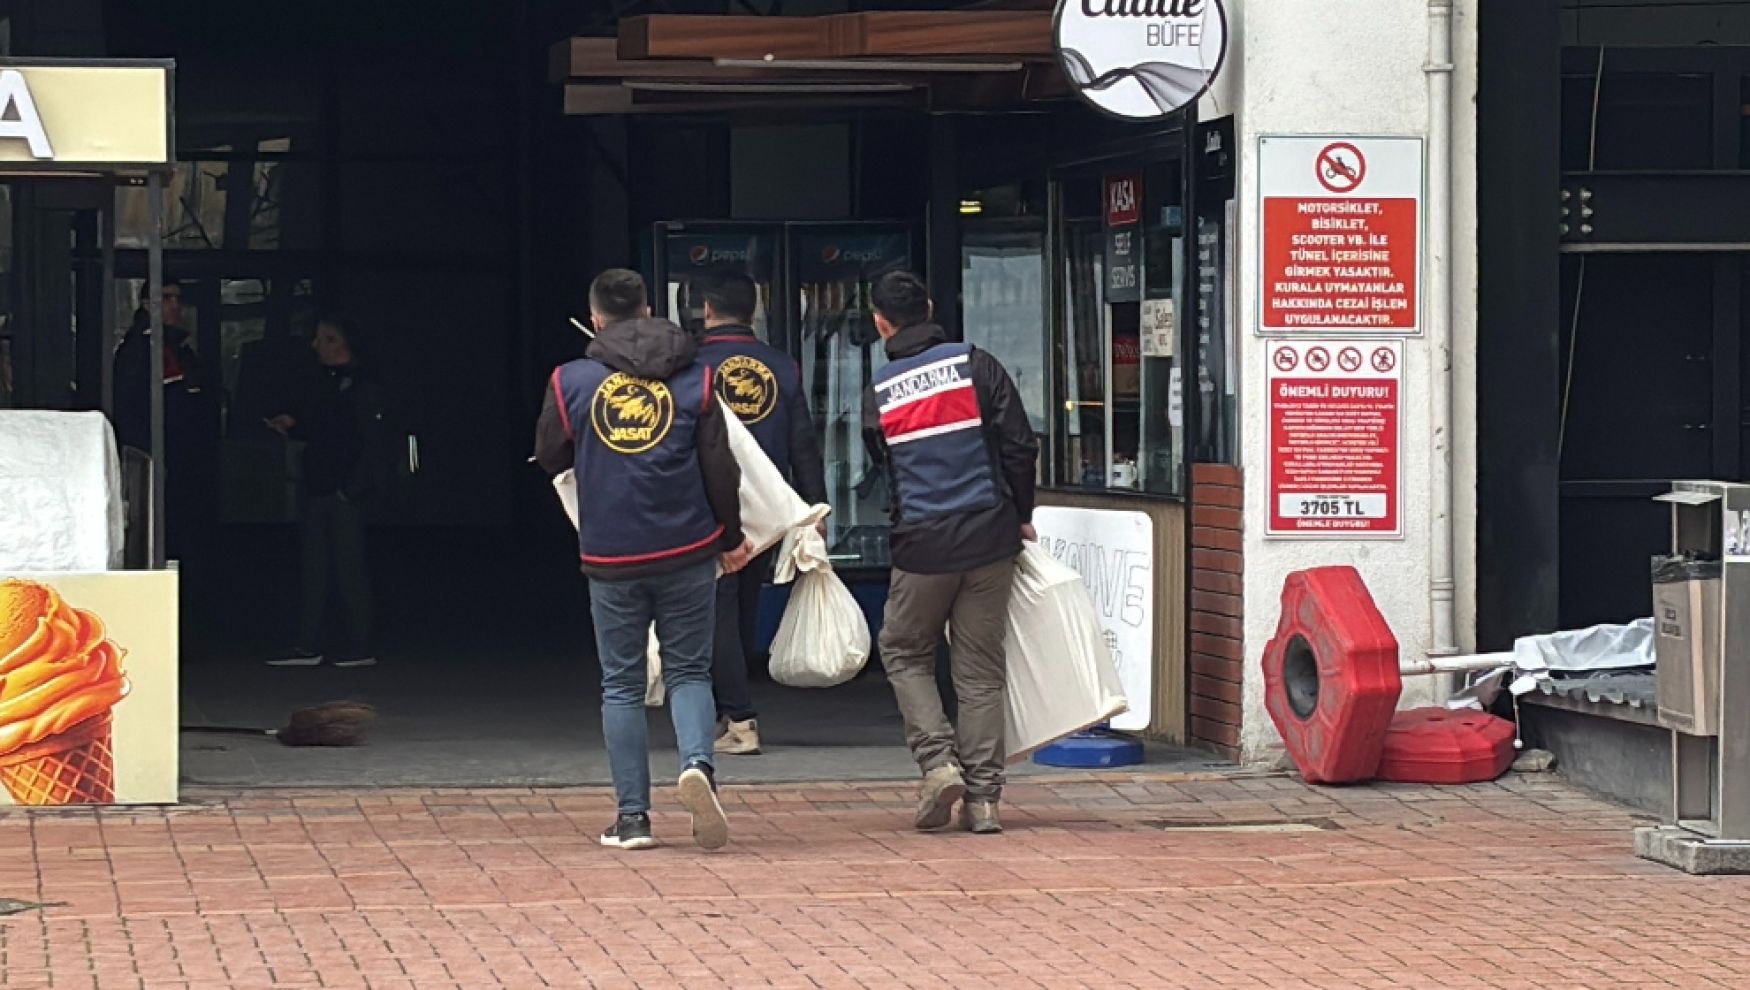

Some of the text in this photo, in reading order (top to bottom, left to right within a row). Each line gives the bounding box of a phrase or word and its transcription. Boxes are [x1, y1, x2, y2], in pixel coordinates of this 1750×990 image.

[1147, 20, 1200, 47] BÜFE
[1110, 179, 1135, 212] KASA
[1297, 200, 1383, 216] MOTORSİKLET,
[1311, 217, 1369, 231] BİSİKLET,
[1291, 233, 1388, 245] SCOOTER VB. İLE
[1290, 249, 1390, 264] TÜNEL İÇERİSİNE
[1284, 265, 1394, 277] GİRMEK YASAKTIR.
[1275, 282, 1404, 293] KURALA UYMAYANLAR
[1272, 297, 1407, 312] HAKKINDA CEZAİ İŞLEM
[1284, 314, 1394, 325] UYGULANACAKTIR.
[887, 365, 960, 403] JANDARMA
[1279, 383, 1389, 399] ÖNEMLİ DUYURU!
[609, 427, 653, 441] JASAT
[1300, 502, 1365, 515] 3705 TL
